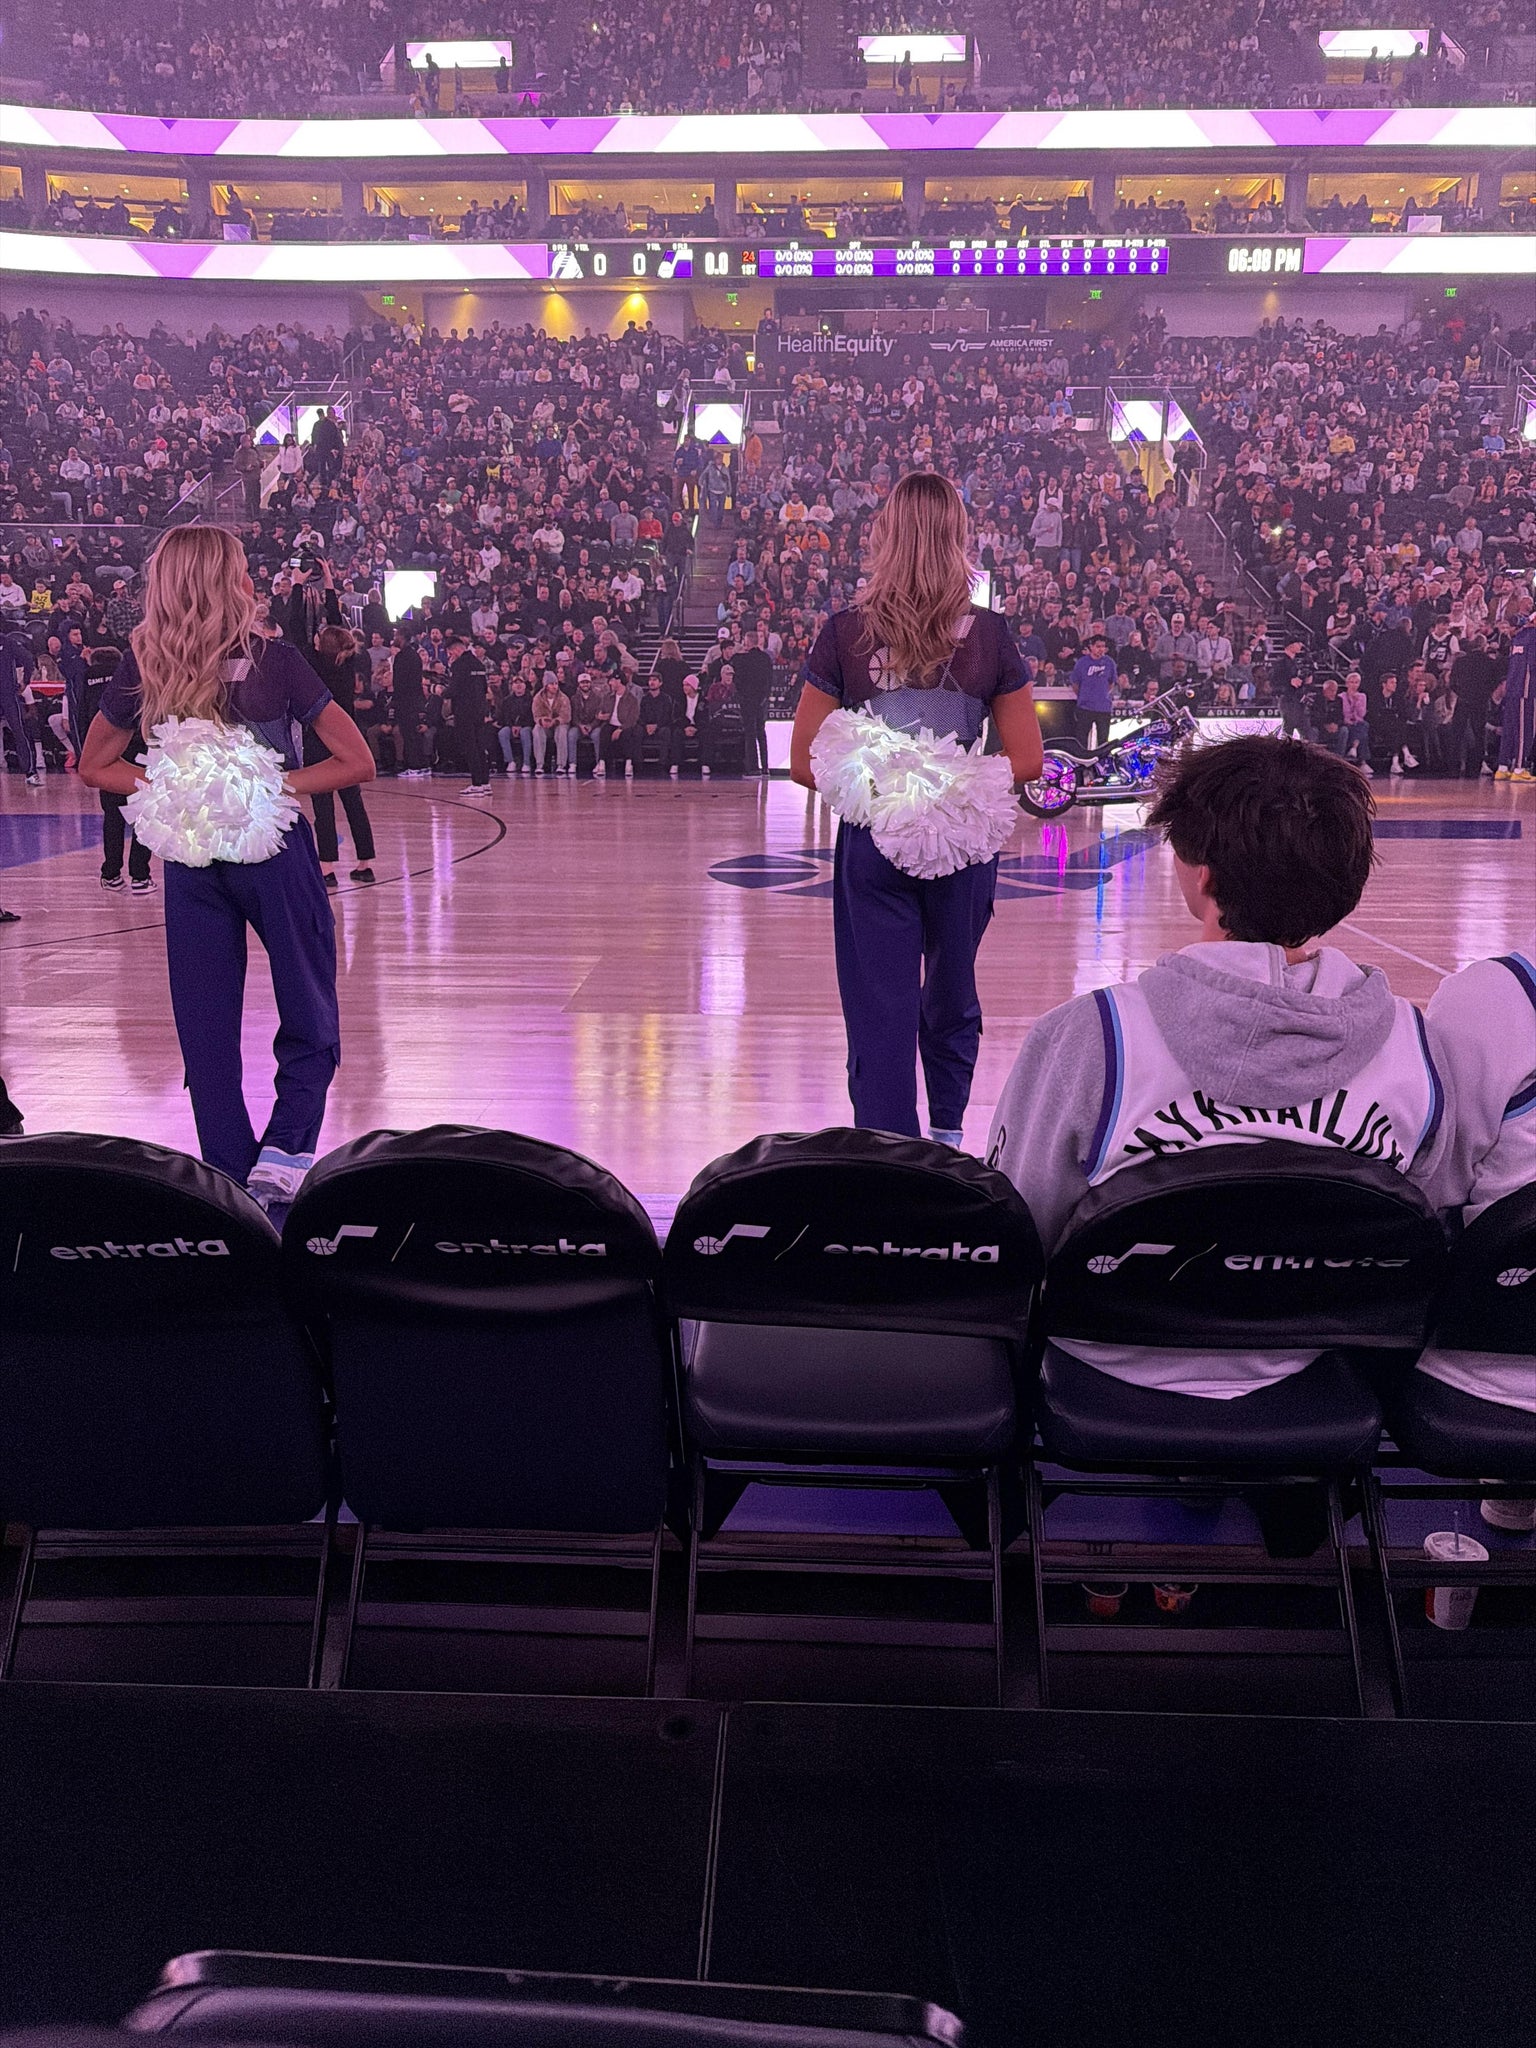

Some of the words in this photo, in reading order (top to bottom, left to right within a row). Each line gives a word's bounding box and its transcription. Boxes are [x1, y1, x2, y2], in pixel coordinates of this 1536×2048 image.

[593, 253, 607, 276] 0
[633, 253, 646, 275] 0
[704, 252, 729, 275] 0.0
[743, 251, 756, 262] 24
[775, 251, 793, 262] 0/0
[793, 251, 813, 263] (0%)
[835, 250, 853, 261] 0/0
[854, 250, 874, 262] (0%)
[896, 250, 914, 261] 0/0
[915, 250, 935, 262] (0%)
[953, 250, 961, 261] 0
[975, 250, 983, 261] 0
[996, 250, 1004, 261] 0
[1018, 250, 1026, 260] 0
[1040, 249, 1048, 260] 0
[1062, 249, 1070, 260] 0
[1084, 249, 1092, 260] 0
[1107, 249, 1116, 260] 0
[1129, 249, 1138, 260] 0
[1151, 248, 1160, 260] 0
[1228, 248, 1272, 272] 06:08
[1274, 248, 1301, 272] PM
[741, 264, 757, 275] 1ST
[775, 264, 793, 275] 0/0
[793, 264, 813, 276] (0%)
[835, 263, 853, 274] 0/0
[854, 263, 874, 275] (0%)
[896, 263, 914, 274] 0/0
[915, 263, 935, 275] (0%)
[953, 263, 961, 274] 0
[975, 263, 983, 274] 0
[996, 263, 1004, 274] 0
[1018, 262, 1026, 274] 0
[1040, 262, 1048, 273] 0
[1062, 262, 1070, 273] 0
[1084, 262, 1092, 273] 0
[1107, 262, 1116, 273] 0
[1129, 262, 1138, 273] 0
[1151, 262, 1160, 272] 0
[778, 335, 895, 356] HealthEquity
[990, 339, 1028, 347] AMERICA
[1029, 339, 1054, 347] FIRST
[50, 1238, 230, 1260] entrata
[434, 1239, 607, 1254] entrata
[824, 1241, 1000, 1263] entrata
